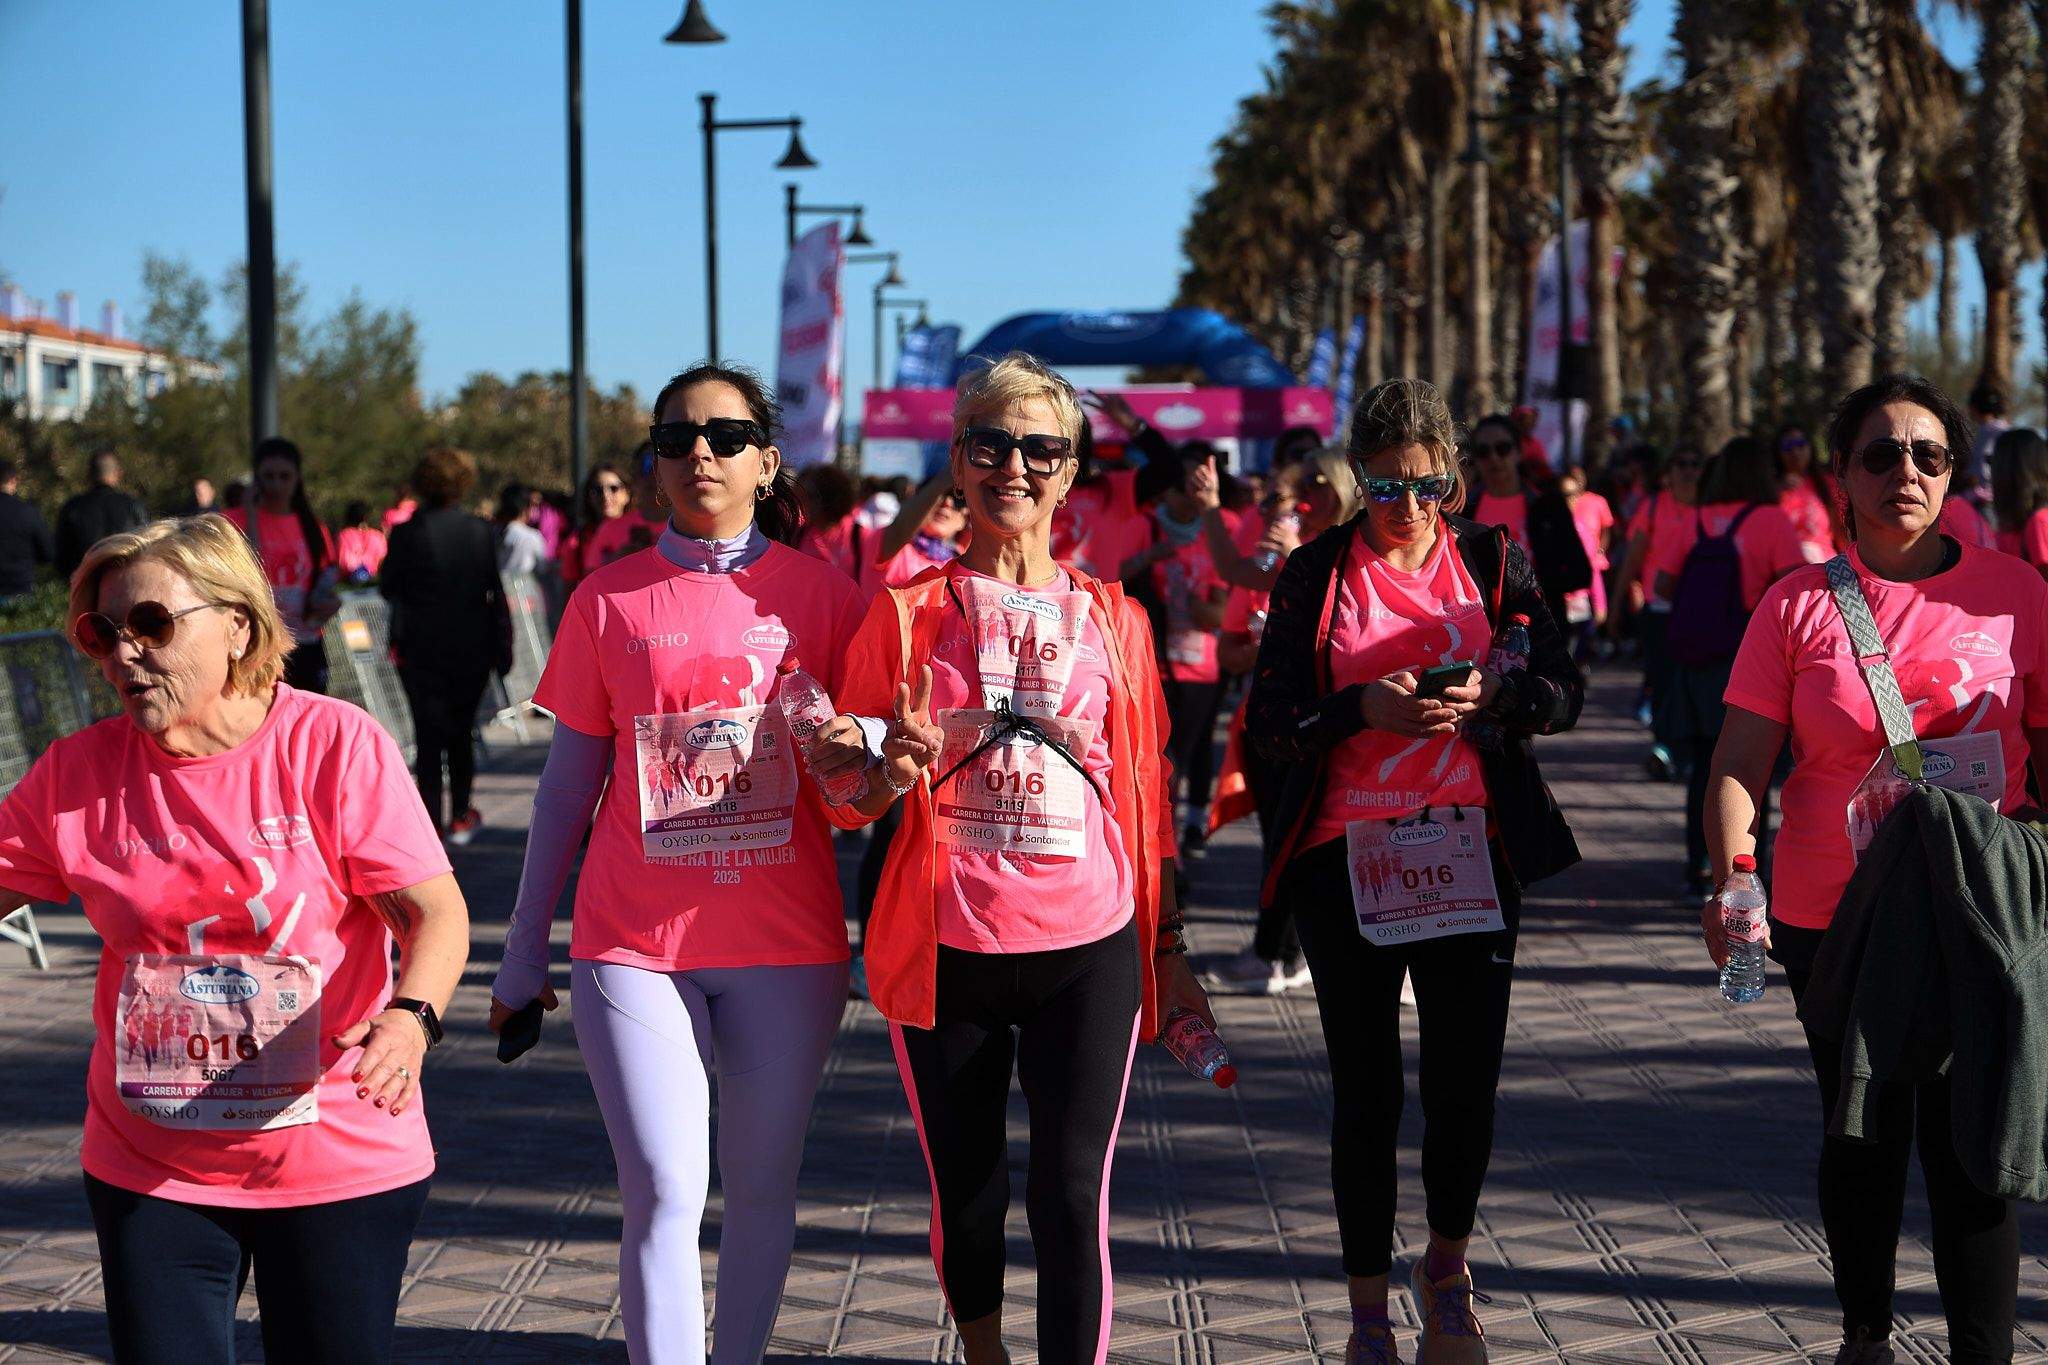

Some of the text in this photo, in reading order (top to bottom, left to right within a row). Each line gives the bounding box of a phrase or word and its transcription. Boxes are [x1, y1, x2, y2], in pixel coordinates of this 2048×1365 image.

[626, 632, 688, 655] OYSHO
[939, 635, 969, 652] OYS
[1008, 634, 1059, 661] 016
[690, 732, 744, 745] ASTURIANA
[695, 771, 752, 798] 016
[985, 769, 1045, 795] 016
[995, 799, 1025, 811] 9119
[1346, 789, 1401, 807] CARRERA
[708, 801, 738, 814] 9118
[664, 810, 783, 830] CARRERA DE LA MUJER VALENCIA
[952, 808, 982, 820] CARRERA
[983, 812, 993, 821] DE
[994, 812, 1004, 821] LA
[1005, 813, 1031, 824] MUJER
[742, 828, 788, 841] Santander
[948, 824, 995, 840] OYSHO
[1025, 834, 1071, 846] Santander
[1394, 828, 1445, 842] ASTURIANA
[115, 832, 187, 858] OYSHO
[661, 833, 712, 849] OYSHO
[711, 850, 731, 867] DE
[735, 850, 751, 867] LA
[754, 845, 797, 867] MUJER
[713, 870, 741, 884] 2025
[1401, 864, 1455, 890] 016
[1416, 891, 1441, 904] 1562
[1376, 901, 1483, 922] CARRERA DE LA MUJER VALENCIA
[1376, 922, 1421, 938] OYSHO
[1448, 917, 1489, 927] Santander
[185, 978, 254, 996] ASTURIANA
[186, 1033, 260, 1062] 016
[201, 1069, 236, 1083] 5067
[142, 1086, 293, 1098] CARRERA DE LA MUJER VALENCIA
[141, 1105, 199, 1120] OYSHO
[238, 1105, 297, 1120] Santander
